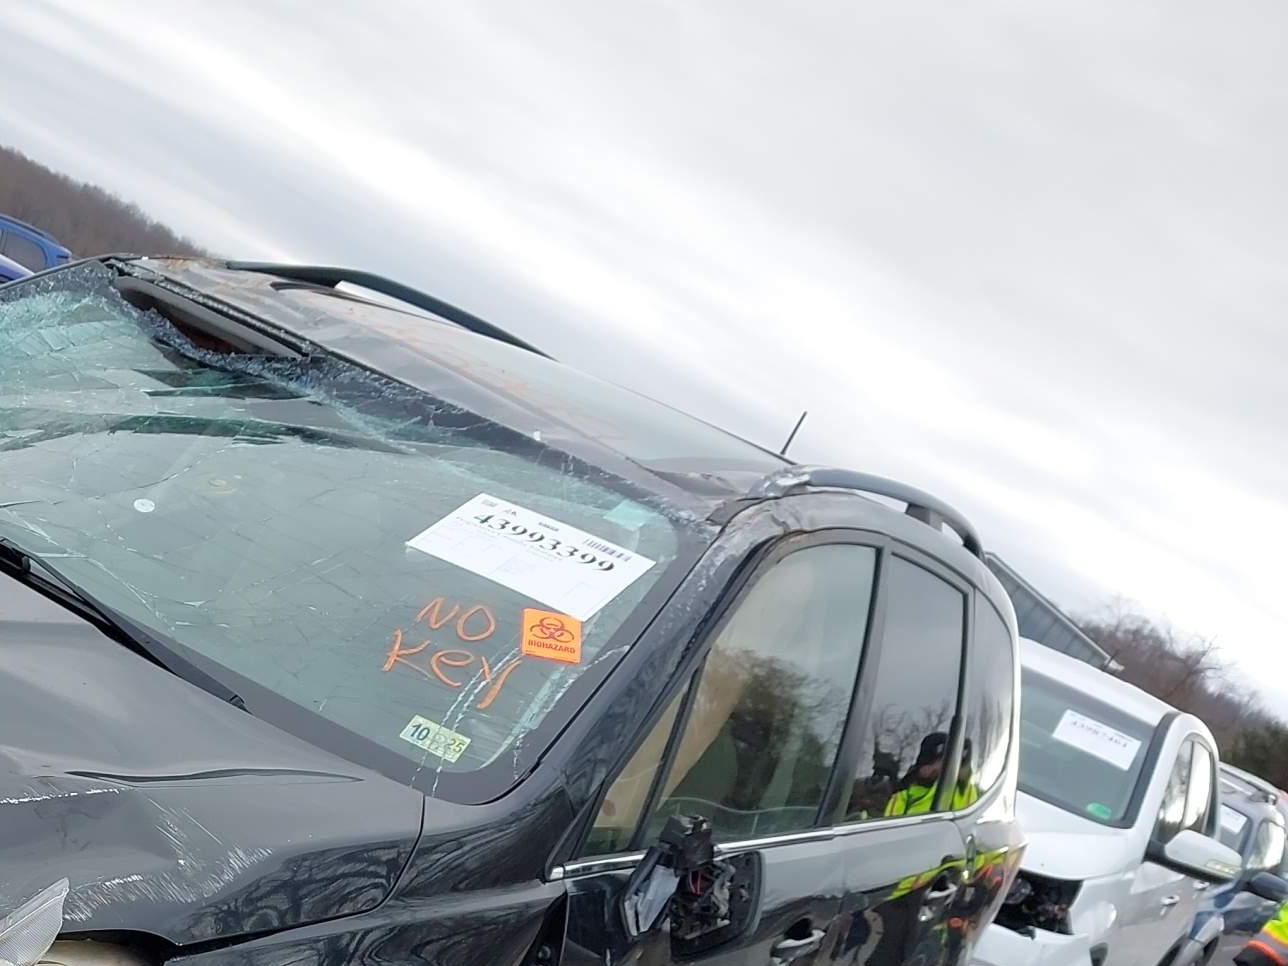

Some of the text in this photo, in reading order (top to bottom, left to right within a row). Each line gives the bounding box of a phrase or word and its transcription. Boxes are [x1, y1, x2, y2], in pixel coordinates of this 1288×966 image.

[473, 514, 615, 572] 43993399
[416, 597, 495, 641] NO
[528, 640, 576, 655] BIOHAZARD
[410, 723, 431, 741] 10
[447, 738, 466, 753] 25
